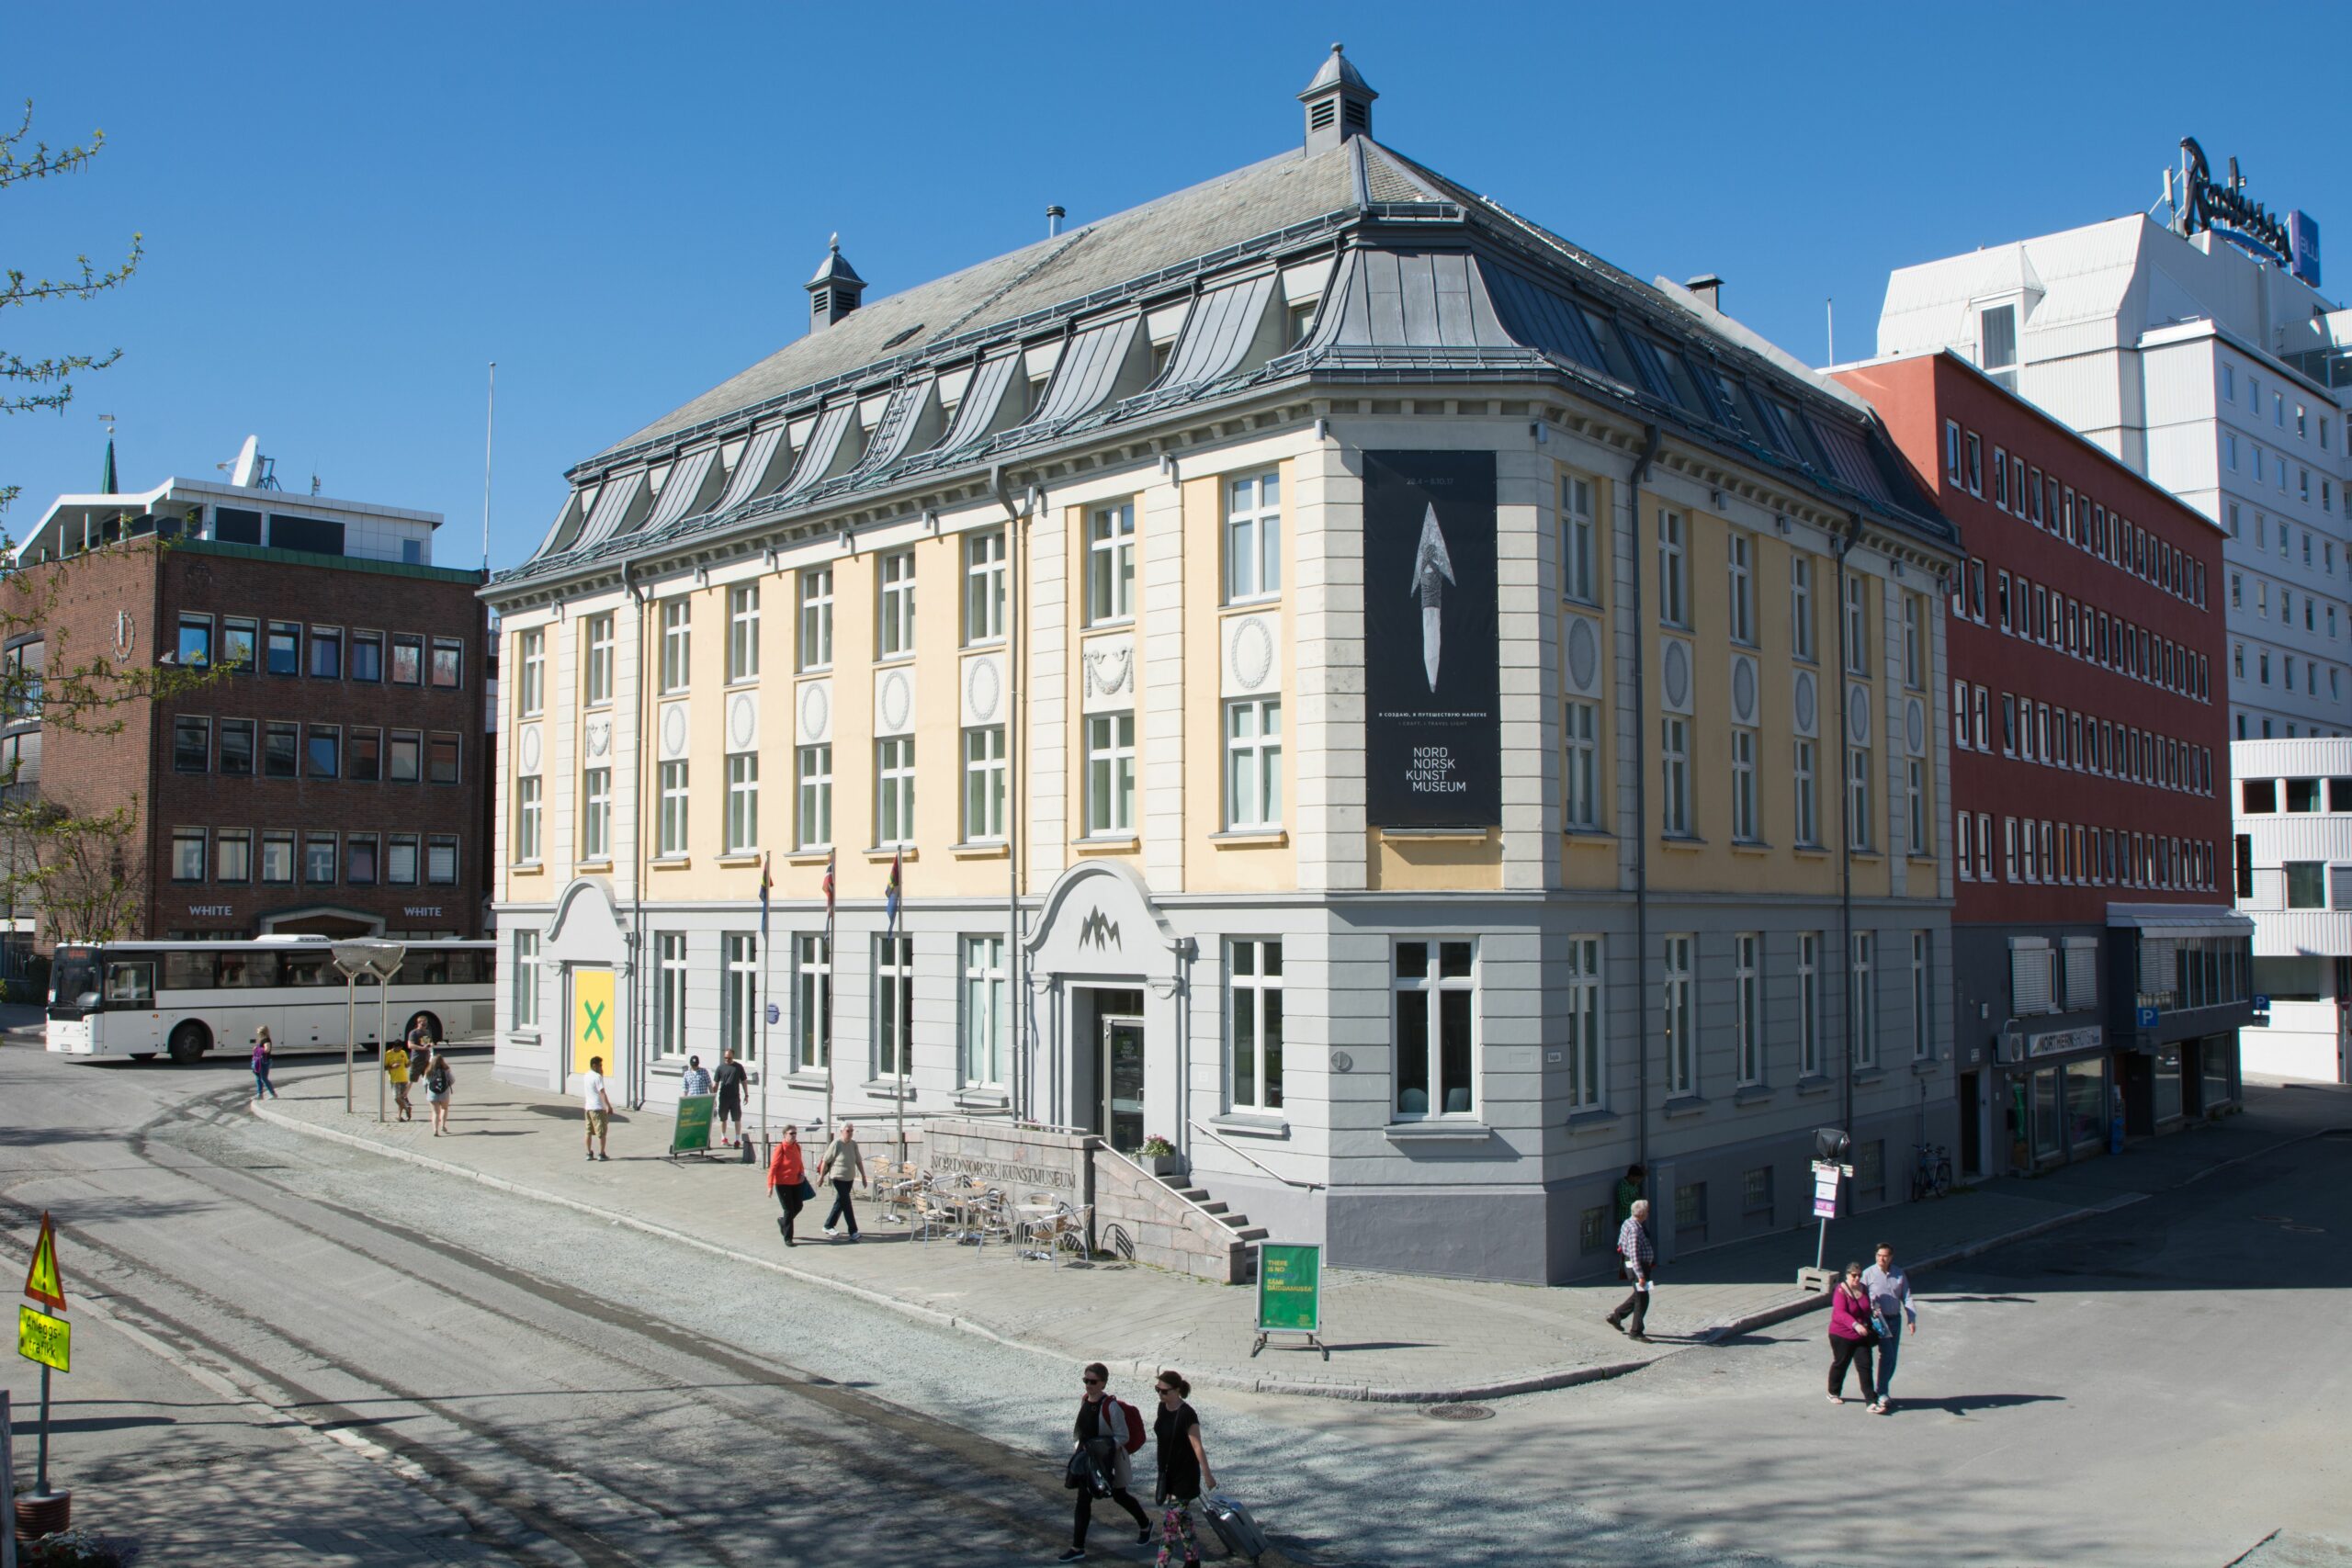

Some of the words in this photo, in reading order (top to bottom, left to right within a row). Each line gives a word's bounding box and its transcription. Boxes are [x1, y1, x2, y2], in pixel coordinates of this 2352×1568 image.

[1413, 747, 1448, 758] NORD
[1414, 758, 1455, 769] NORSK
[1406, 770, 1447, 781] KUNST
[1412, 781, 1466, 792] MUSEUM
[188, 906, 233, 916] WHITE
[404, 907, 442, 917] WHITE
[2256, 996, 2267, 1009] P
[2143, 1010, 2154, 1025] P
[931, 1156, 998, 1178] NORDNORSK
[1001, 1165, 1076, 1189] KUNSTMUSEUM
[27, 1314, 61, 1340] Anleggs-
[28, 1337, 57, 1359] trafikk
